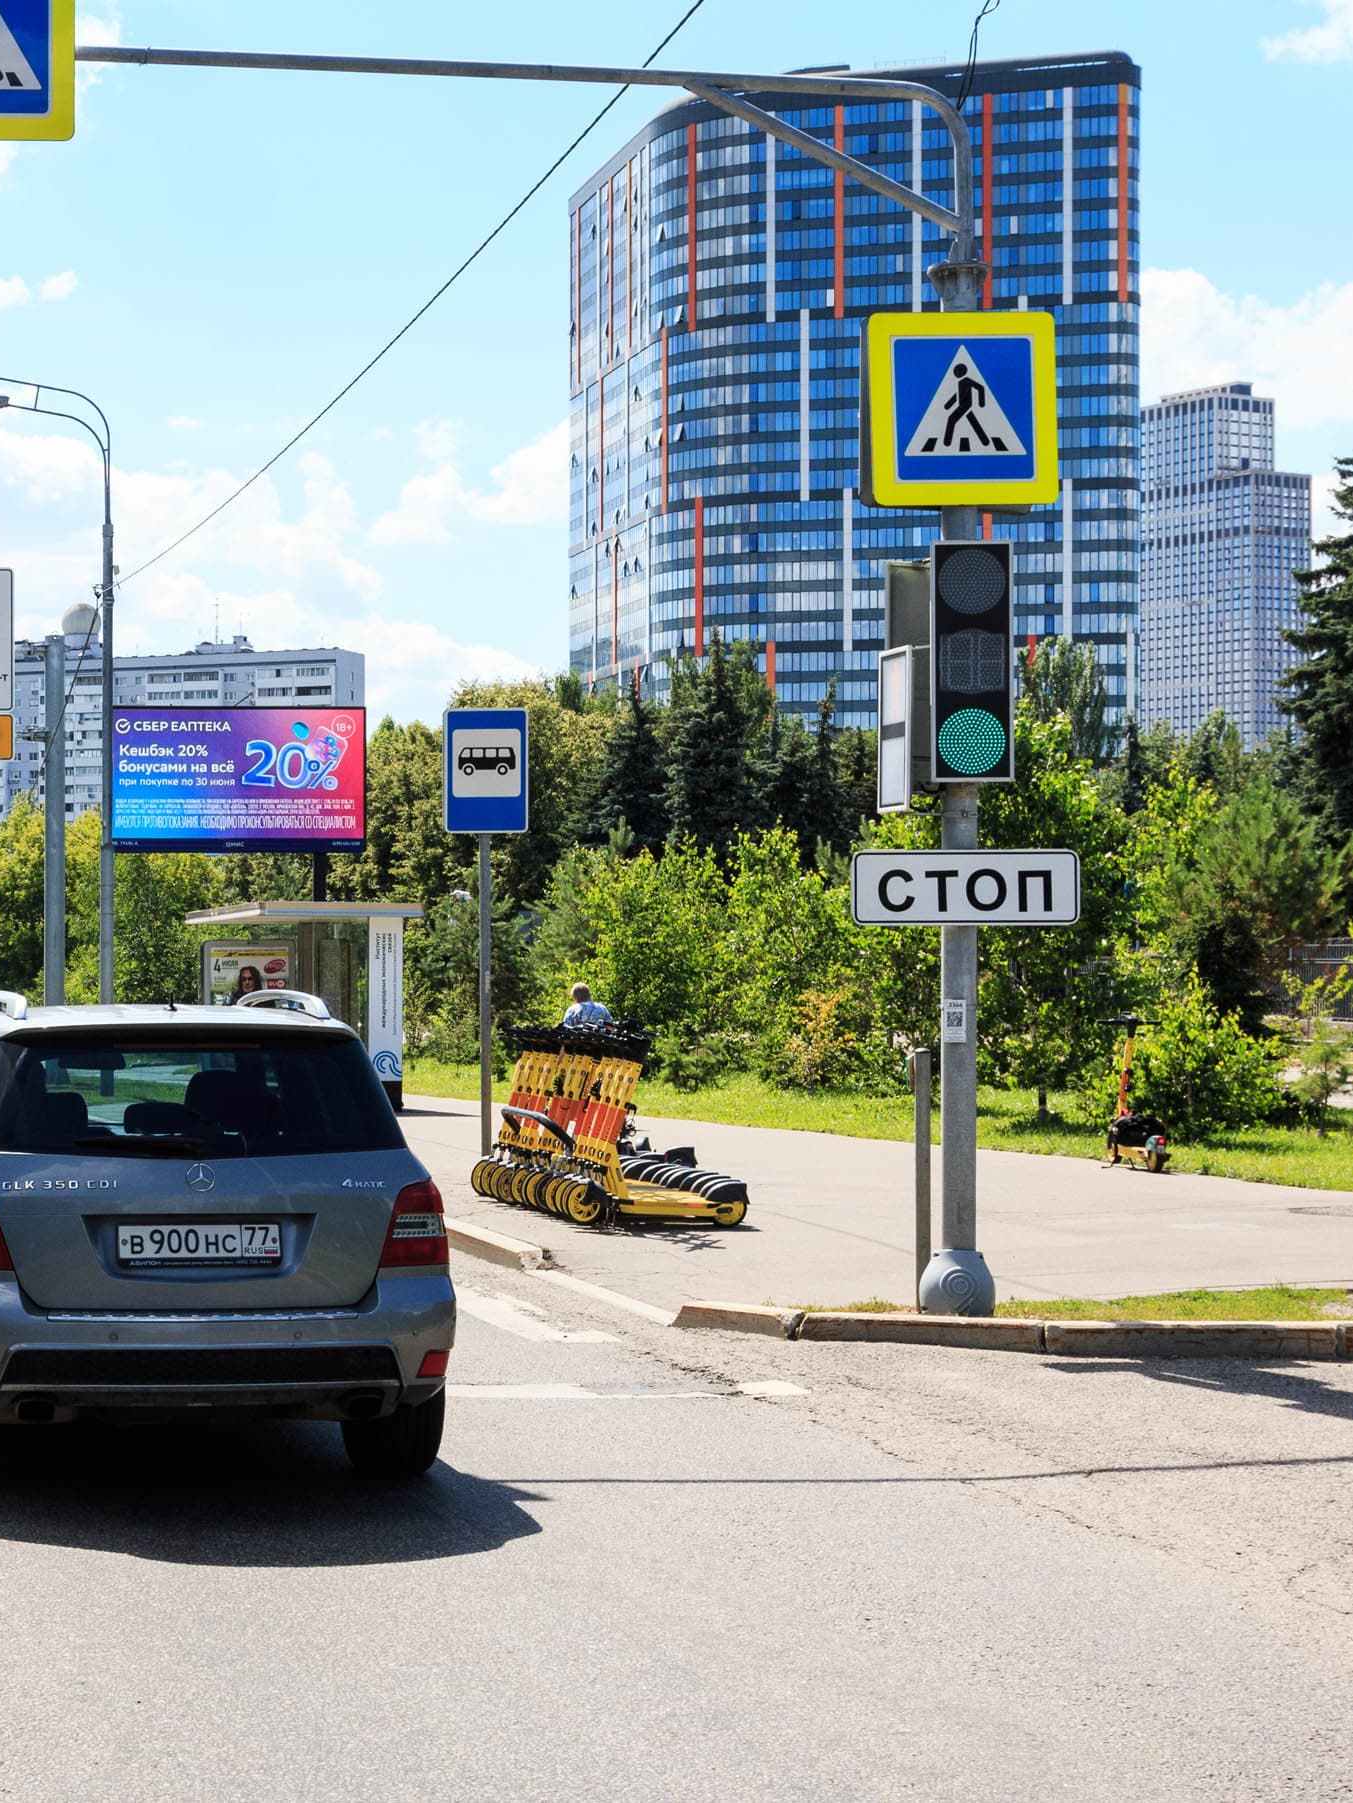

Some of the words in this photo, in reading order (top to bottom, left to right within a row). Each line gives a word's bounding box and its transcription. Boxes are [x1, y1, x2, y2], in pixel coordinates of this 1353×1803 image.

[133, 721, 167, 732] СБЕР
[171, 721, 231, 732] ЕАПТЕКА
[335, 722, 353, 733] 18+
[119, 744, 174, 757] Кешбэк
[178, 745, 208, 757] 20%
[119, 760, 187, 774] бонусами
[191, 763, 208, 773] на
[211, 760, 235, 773] всё
[119, 779, 137, 787] при
[139, 779, 179, 787] покупке
[196, 778, 207, 786] 30
[210, 778, 235, 786] июня
[877, 868, 1053, 912] СТОП
[214, 959, 221, 973] 4
[2, 1180, 35, 1190] GLK
[43, 1179, 79, 1189] 350
[87, 1180, 117, 1189] CDI
[244, 1226, 270, 1246] 77
[244, 1247, 263, 1255] RUS
